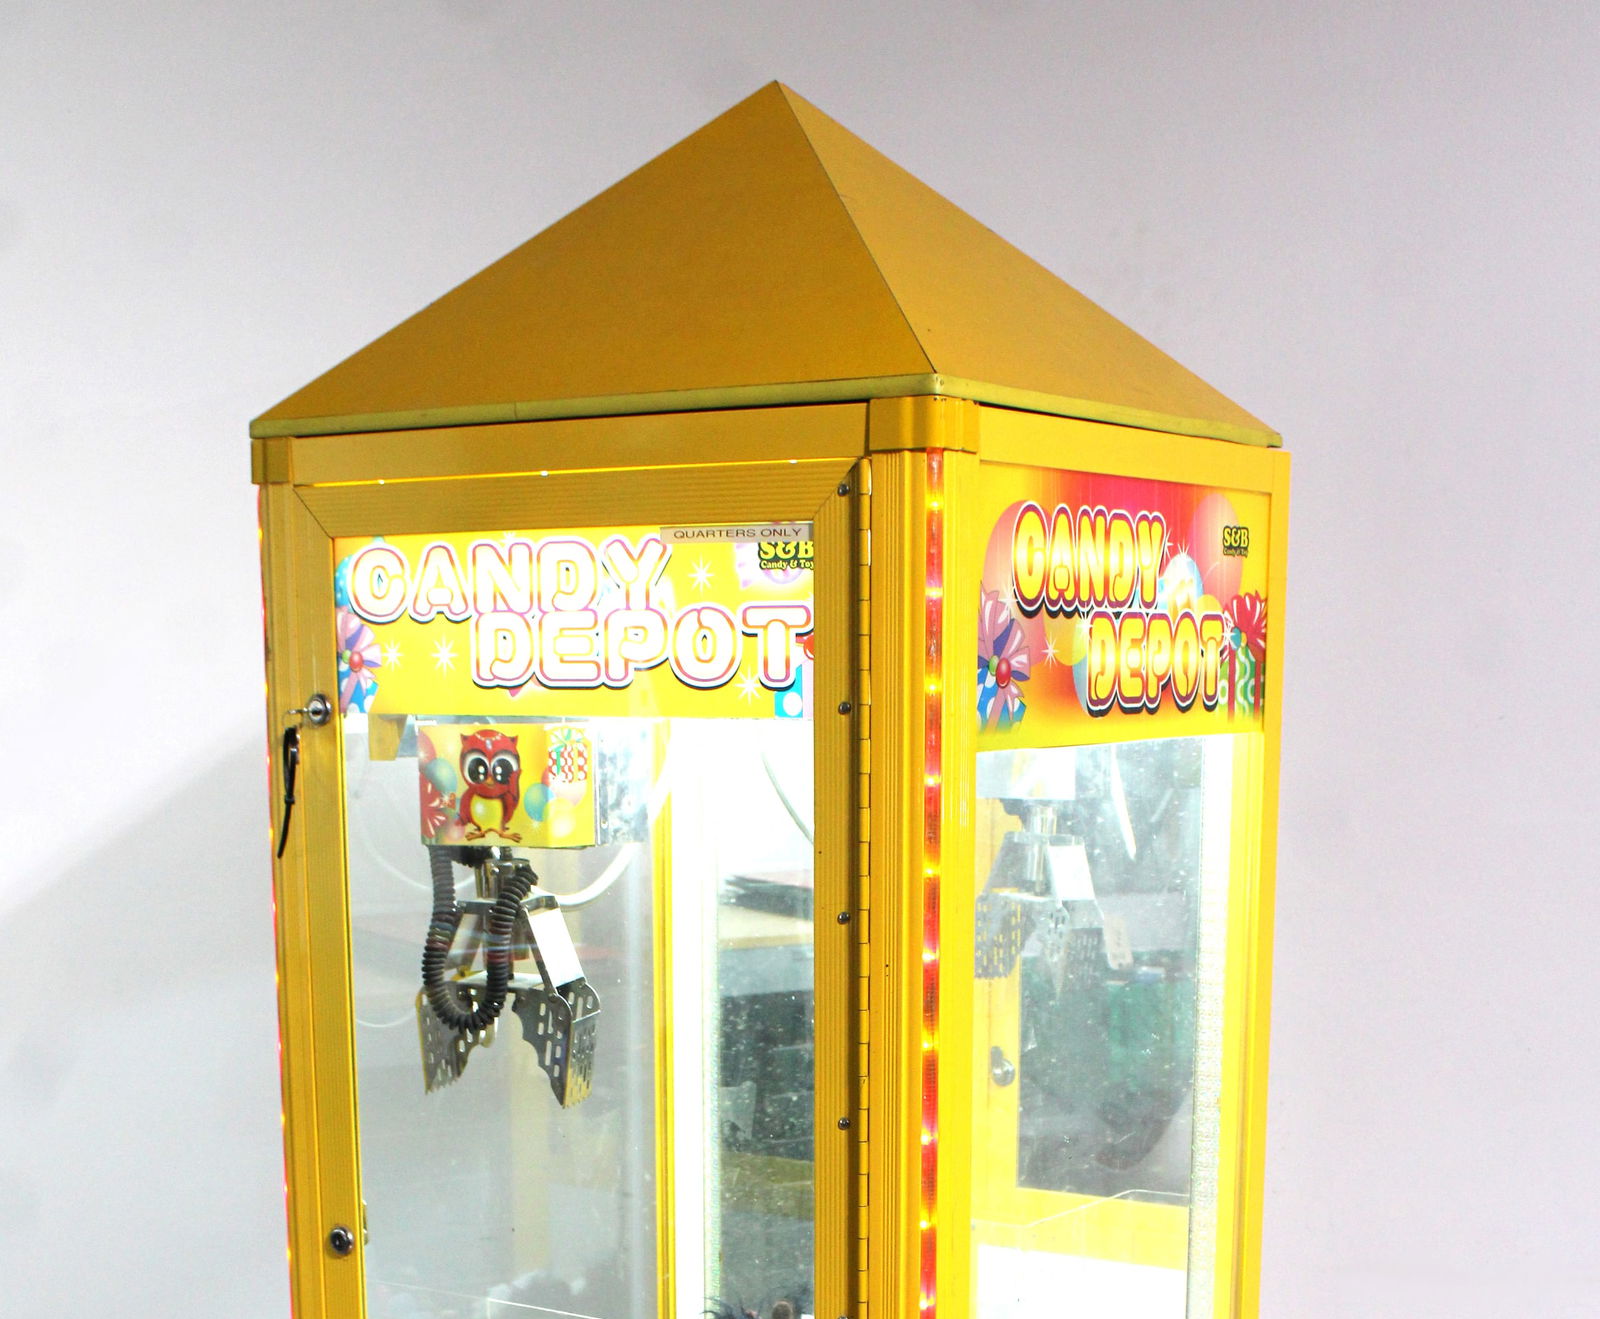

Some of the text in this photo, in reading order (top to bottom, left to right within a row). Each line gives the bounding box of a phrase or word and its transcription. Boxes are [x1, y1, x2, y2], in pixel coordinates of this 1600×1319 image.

[673, 527, 802, 539] QUARTERS ONLY
[760, 560, 788, 571] Candy
[789, 559, 798, 569] &
[1012, 501, 1166, 617] CANDY
[1222, 526, 1249, 547] S&B
[349, 536, 672, 622] CANDY
[472, 604, 815, 690] DEPOT
[1086, 609, 1225, 717] DEPOT
